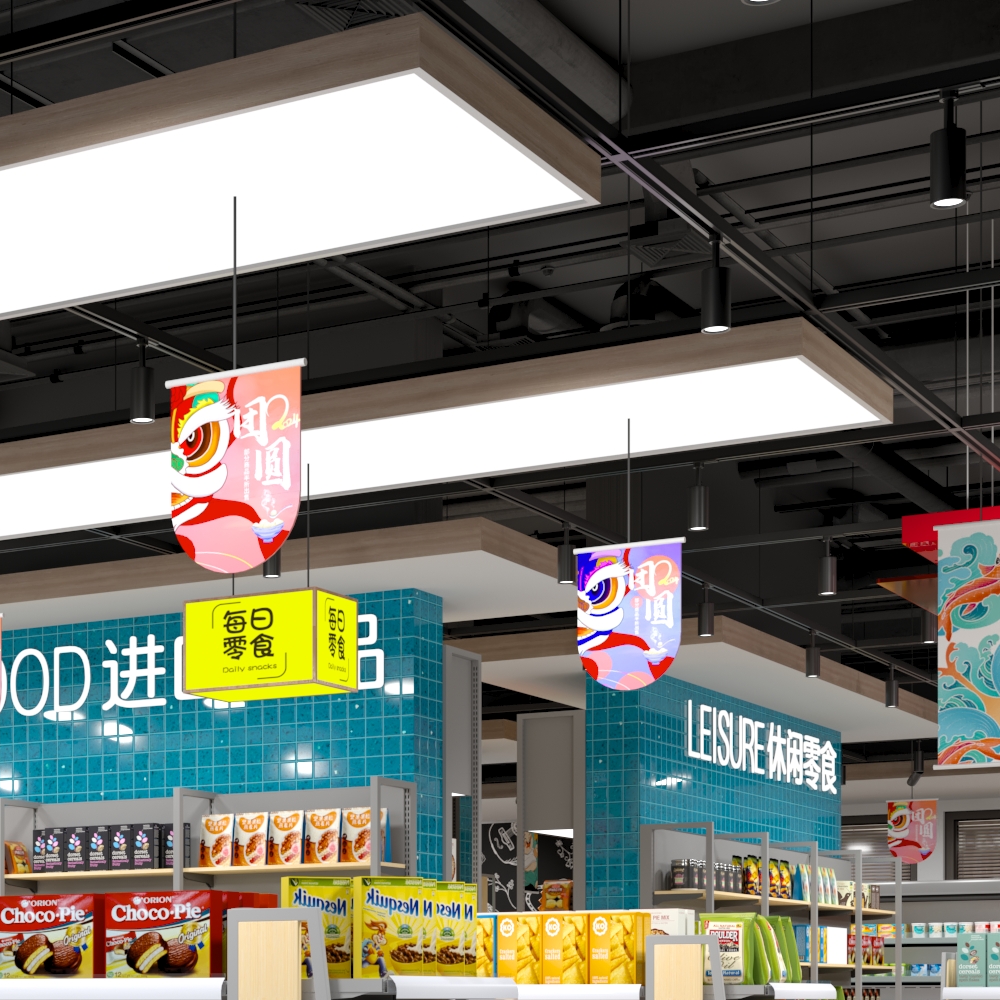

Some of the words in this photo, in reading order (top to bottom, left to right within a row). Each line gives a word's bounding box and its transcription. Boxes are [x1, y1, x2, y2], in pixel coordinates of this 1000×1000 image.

[223, 608, 274, 633] 每日
[328, 606, 346, 632] 每日
[223, 633, 274, 660] 零食
[328, 633, 346, 661] 零食
[222, 664, 245, 674] Daily
[248, 663, 277, 671] snacks
[688, 699, 765, 775] LEISURE
[767, 722, 837, 795] 休闲零食
[141, 896, 172, 904] ORION
[63, 926, 91, 946] Original
[178, 924, 208, 944] Original
[500, 953, 515, 961] salted
